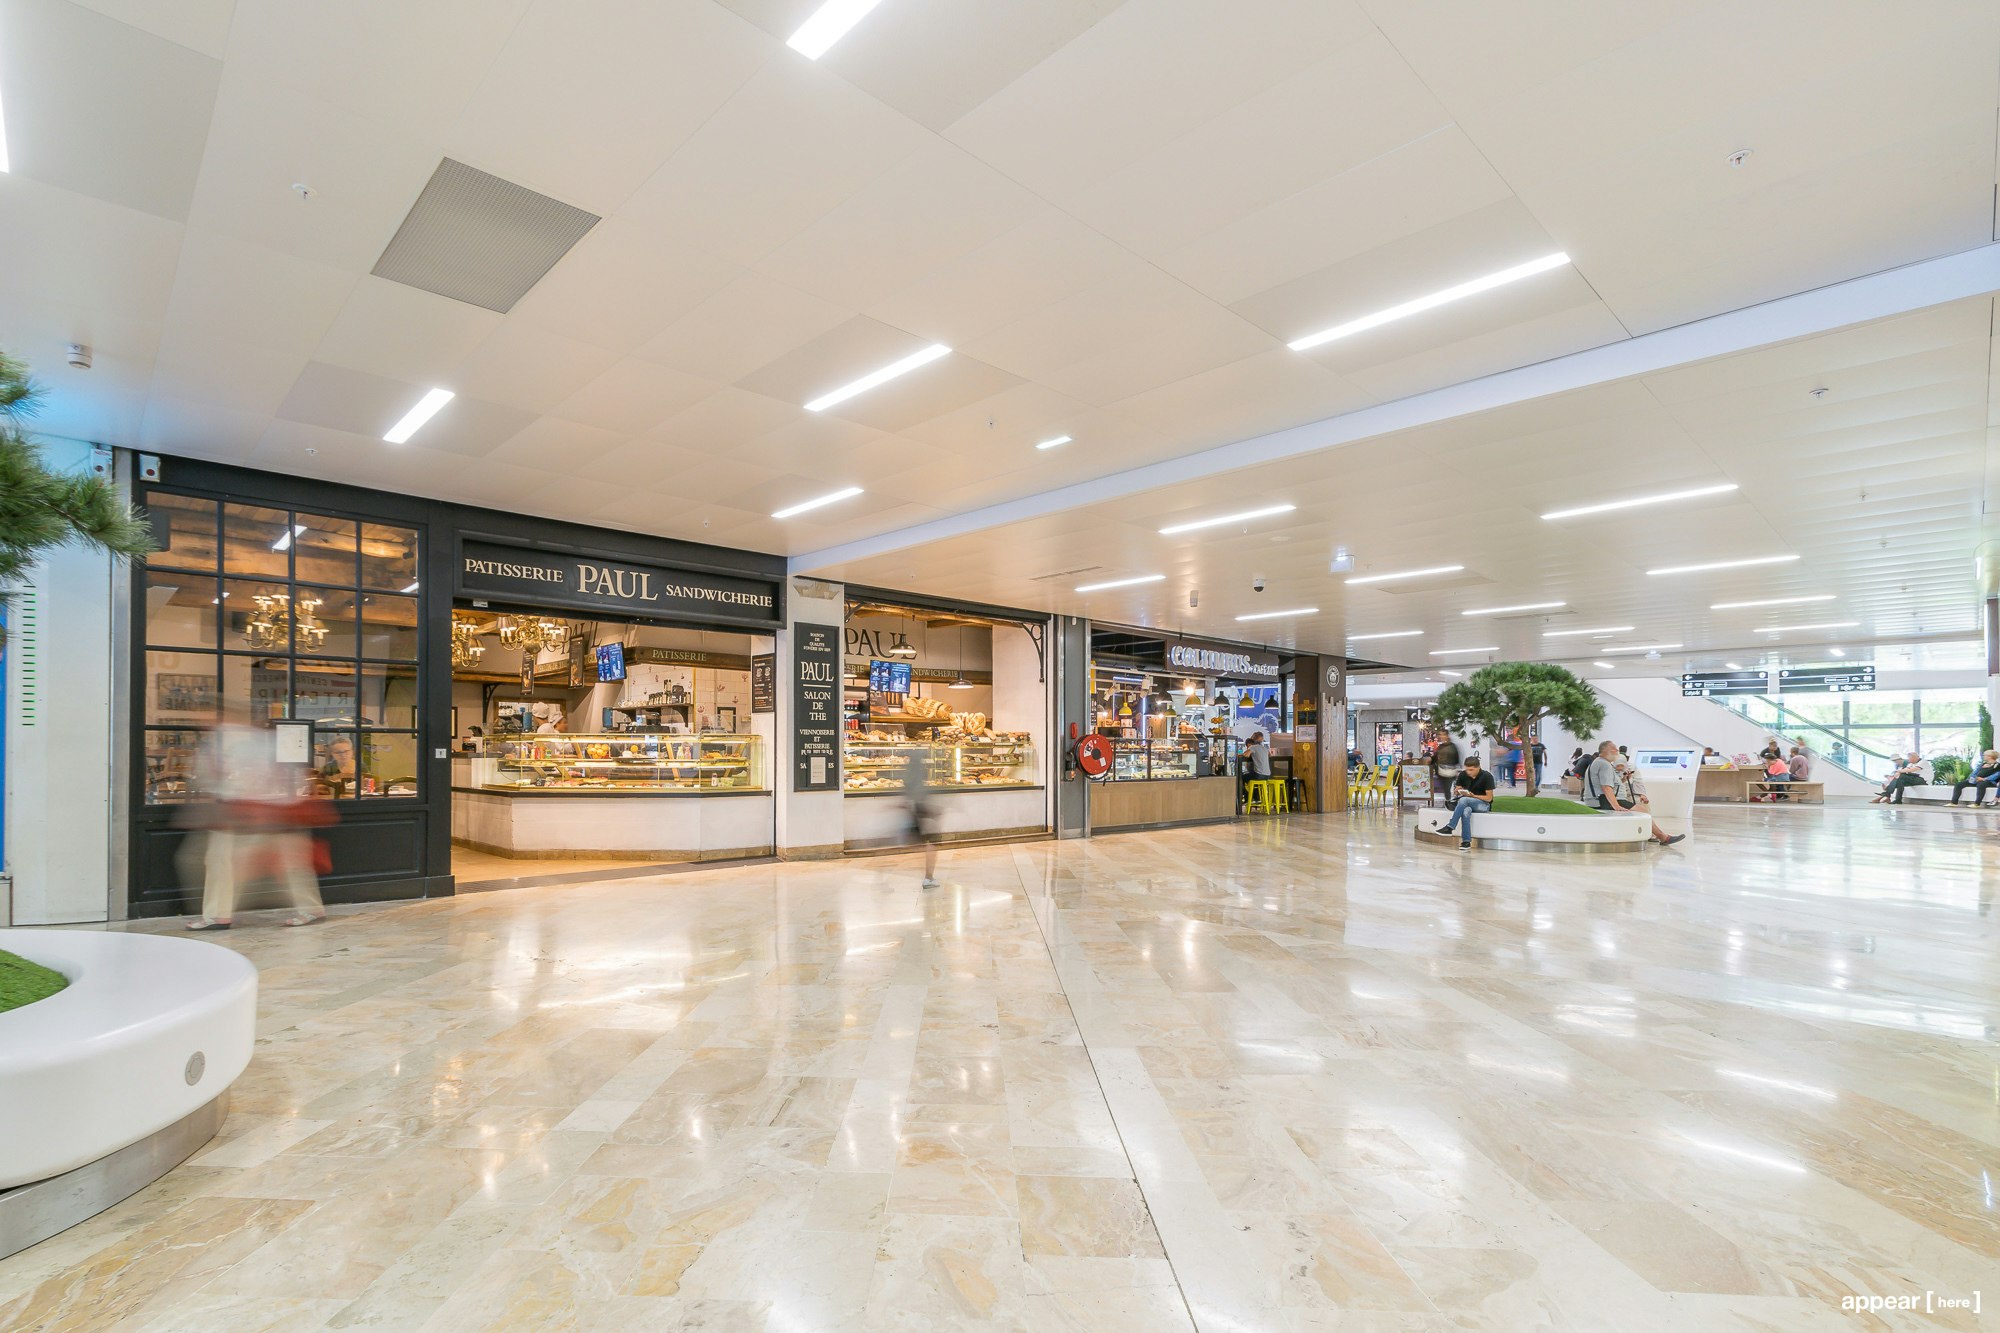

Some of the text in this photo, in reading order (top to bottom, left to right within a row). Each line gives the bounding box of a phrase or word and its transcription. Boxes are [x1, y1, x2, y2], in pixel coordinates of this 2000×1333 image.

[464, 558, 564, 583] PATISSERIE
[577, 564, 659, 600] PAUL
[666, 584, 773, 608] SANDWICHERIE
[652, 649, 707, 661] PATISSERIE
[1171, 645, 1250, 673] COLUMBUS
[800, 661, 834, 682] PAUL
[804, 691, 831, 700] SALON
[812, 701, 824, 710] DE
[809, 712, 827, 721] THE
